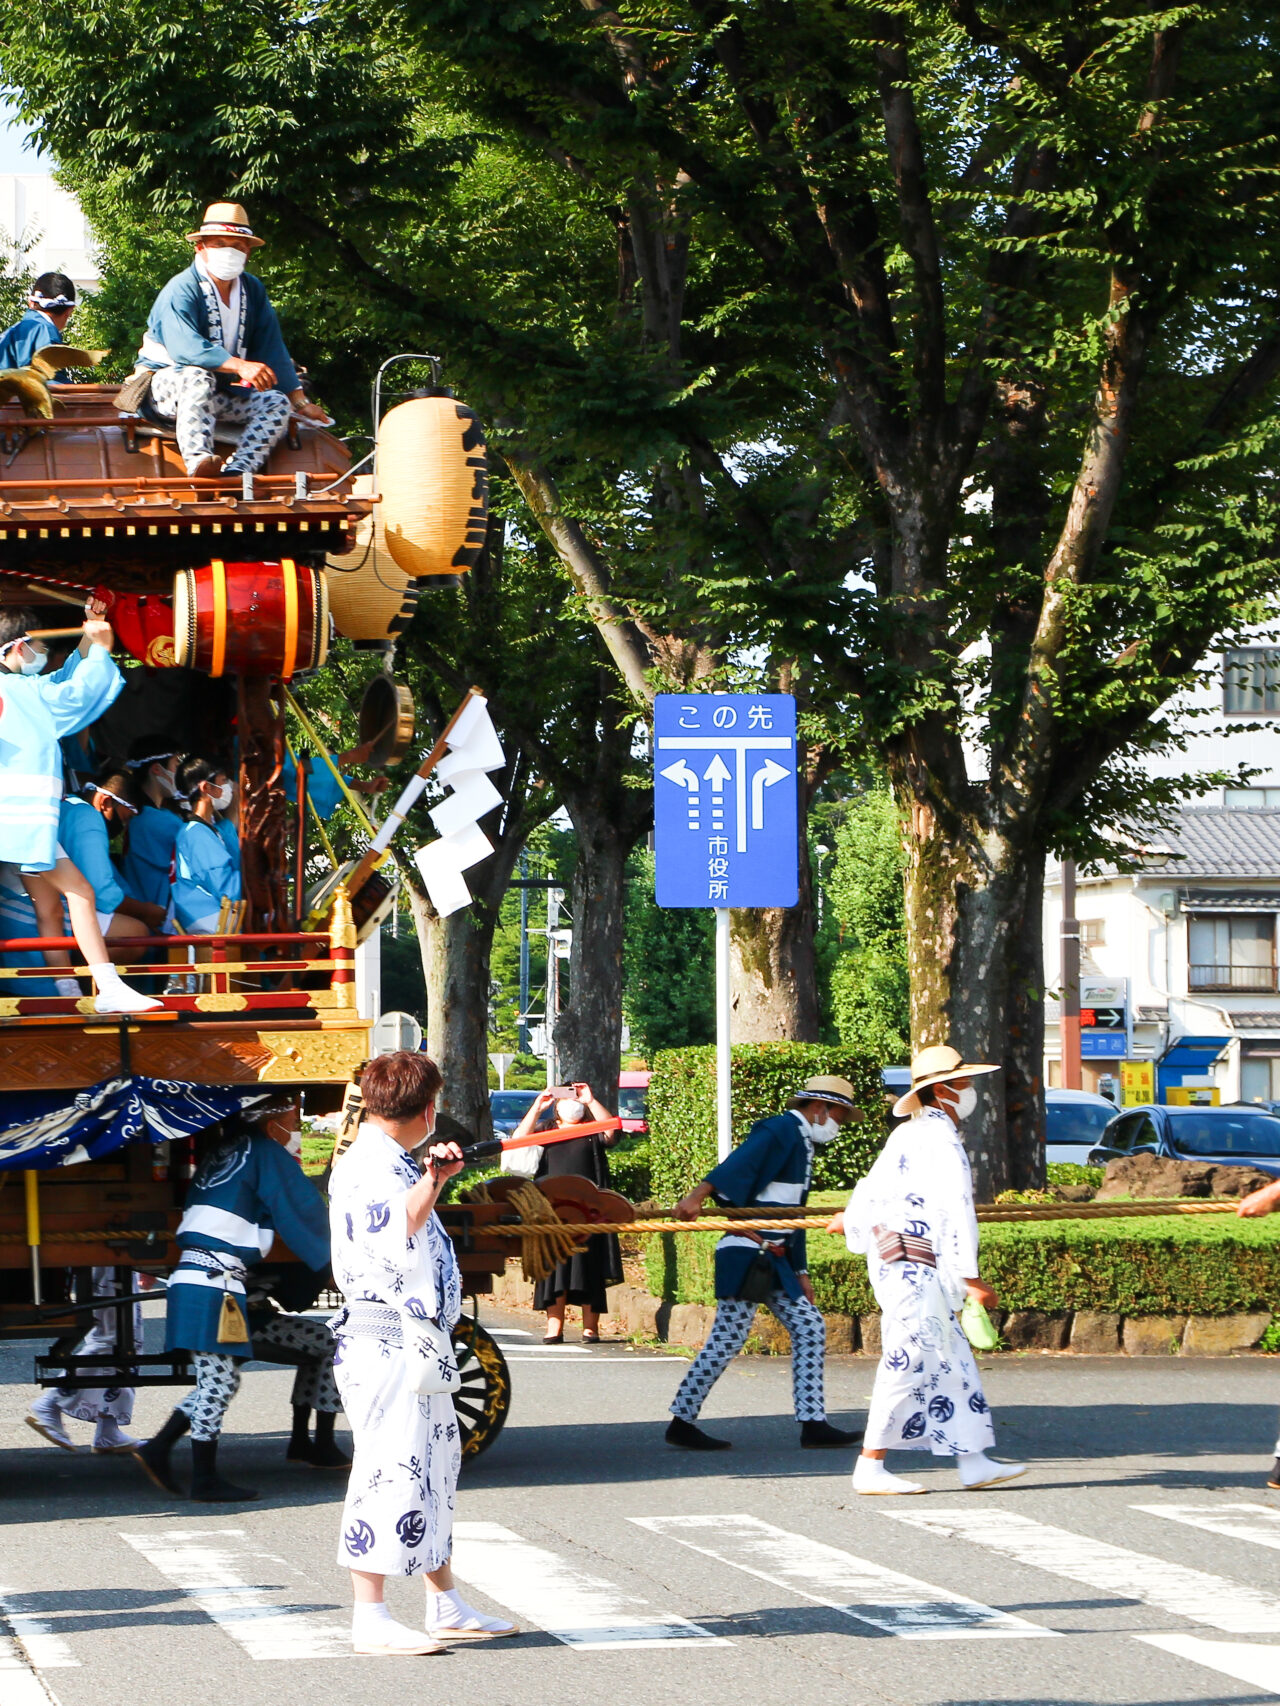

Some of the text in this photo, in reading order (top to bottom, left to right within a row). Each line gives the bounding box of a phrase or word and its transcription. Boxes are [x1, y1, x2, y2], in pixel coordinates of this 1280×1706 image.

[679, 704, 773, 730] この先
[708, 835, 729, 900] 市役所
